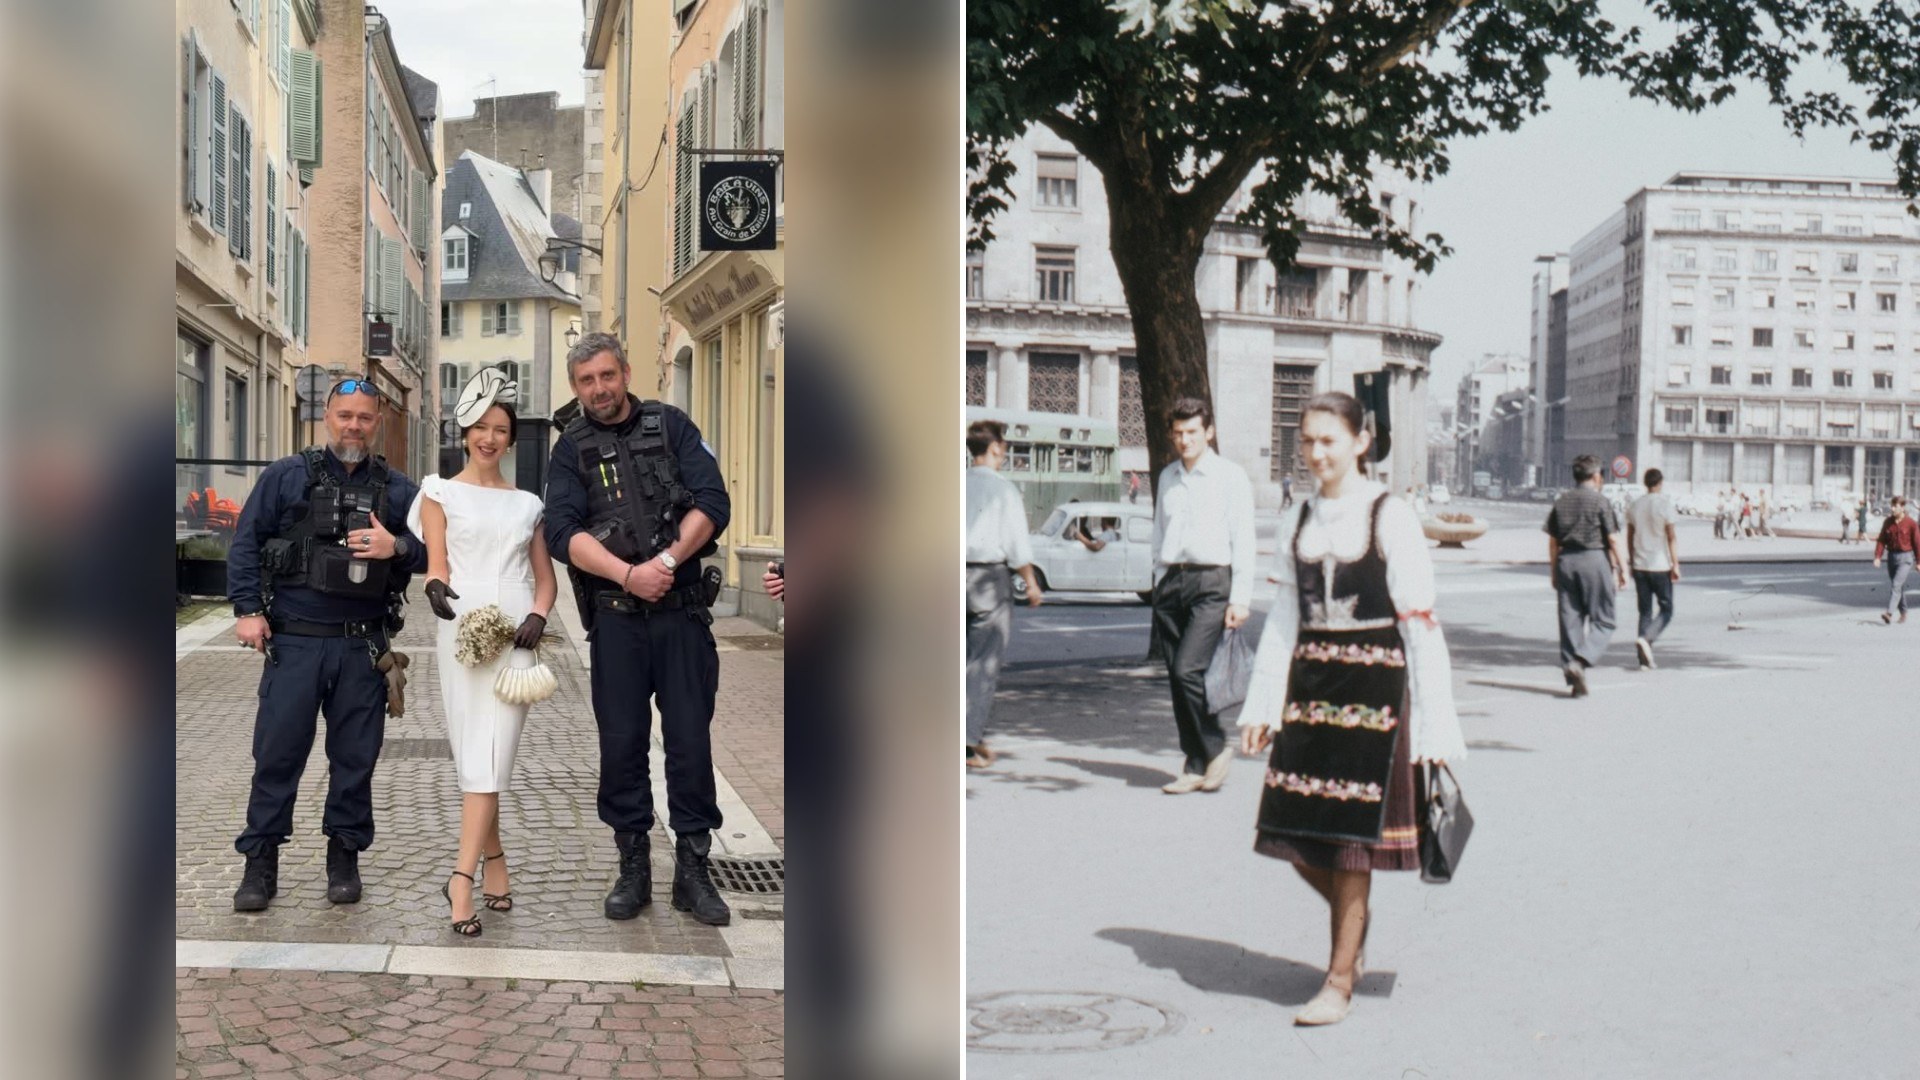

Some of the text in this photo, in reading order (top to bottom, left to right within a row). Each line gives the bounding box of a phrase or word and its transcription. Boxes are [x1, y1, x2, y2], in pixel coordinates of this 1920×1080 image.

[710, 181, 730, 204] BAR
[709, 207, 717, 221] Au
[715, 221, 737, 238] Grain
[749, 208, 767, 234] Raisin
